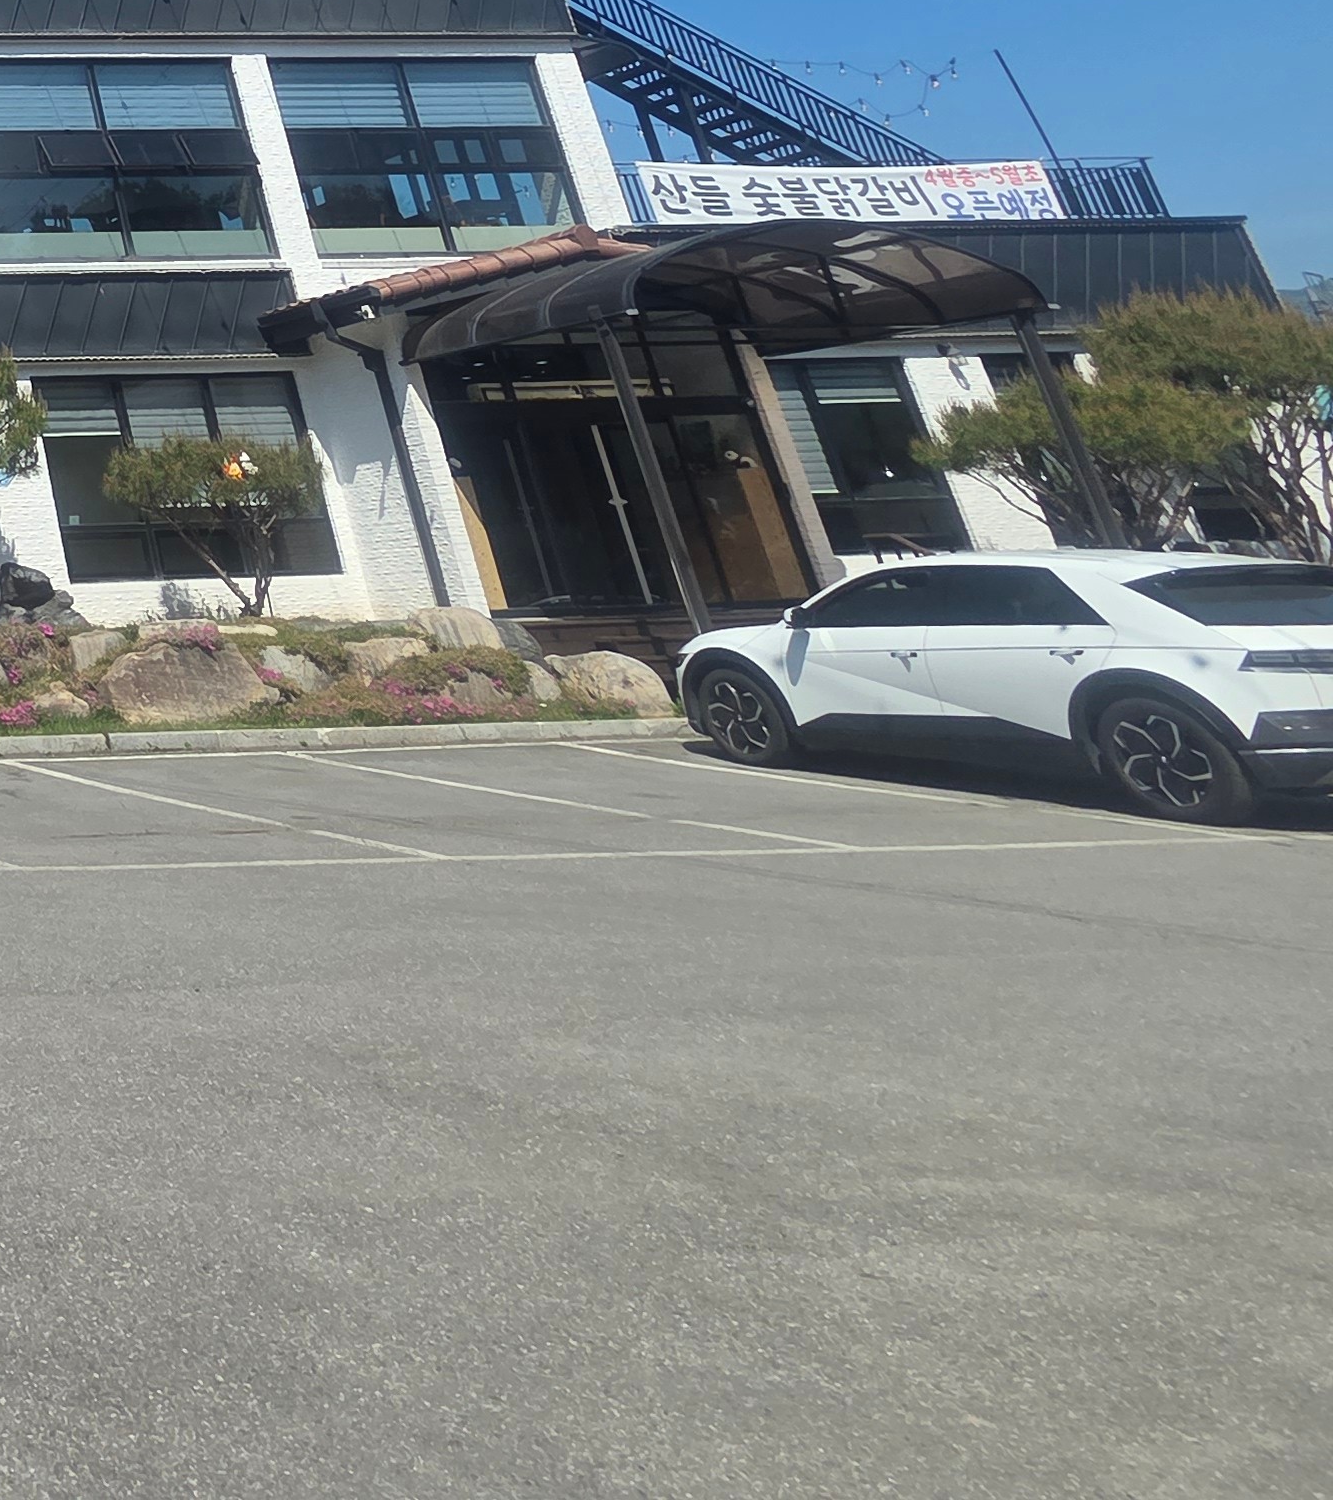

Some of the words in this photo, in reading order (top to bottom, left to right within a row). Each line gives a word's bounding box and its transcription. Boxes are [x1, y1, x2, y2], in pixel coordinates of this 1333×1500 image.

[924, 164, 1043, 188] 4월중~5월초
[651, 174, 734, 217] 산들
[741, 175, 939, 217] 숯불닭갈비
[940, 187, 1058, 220] 오픈예정
